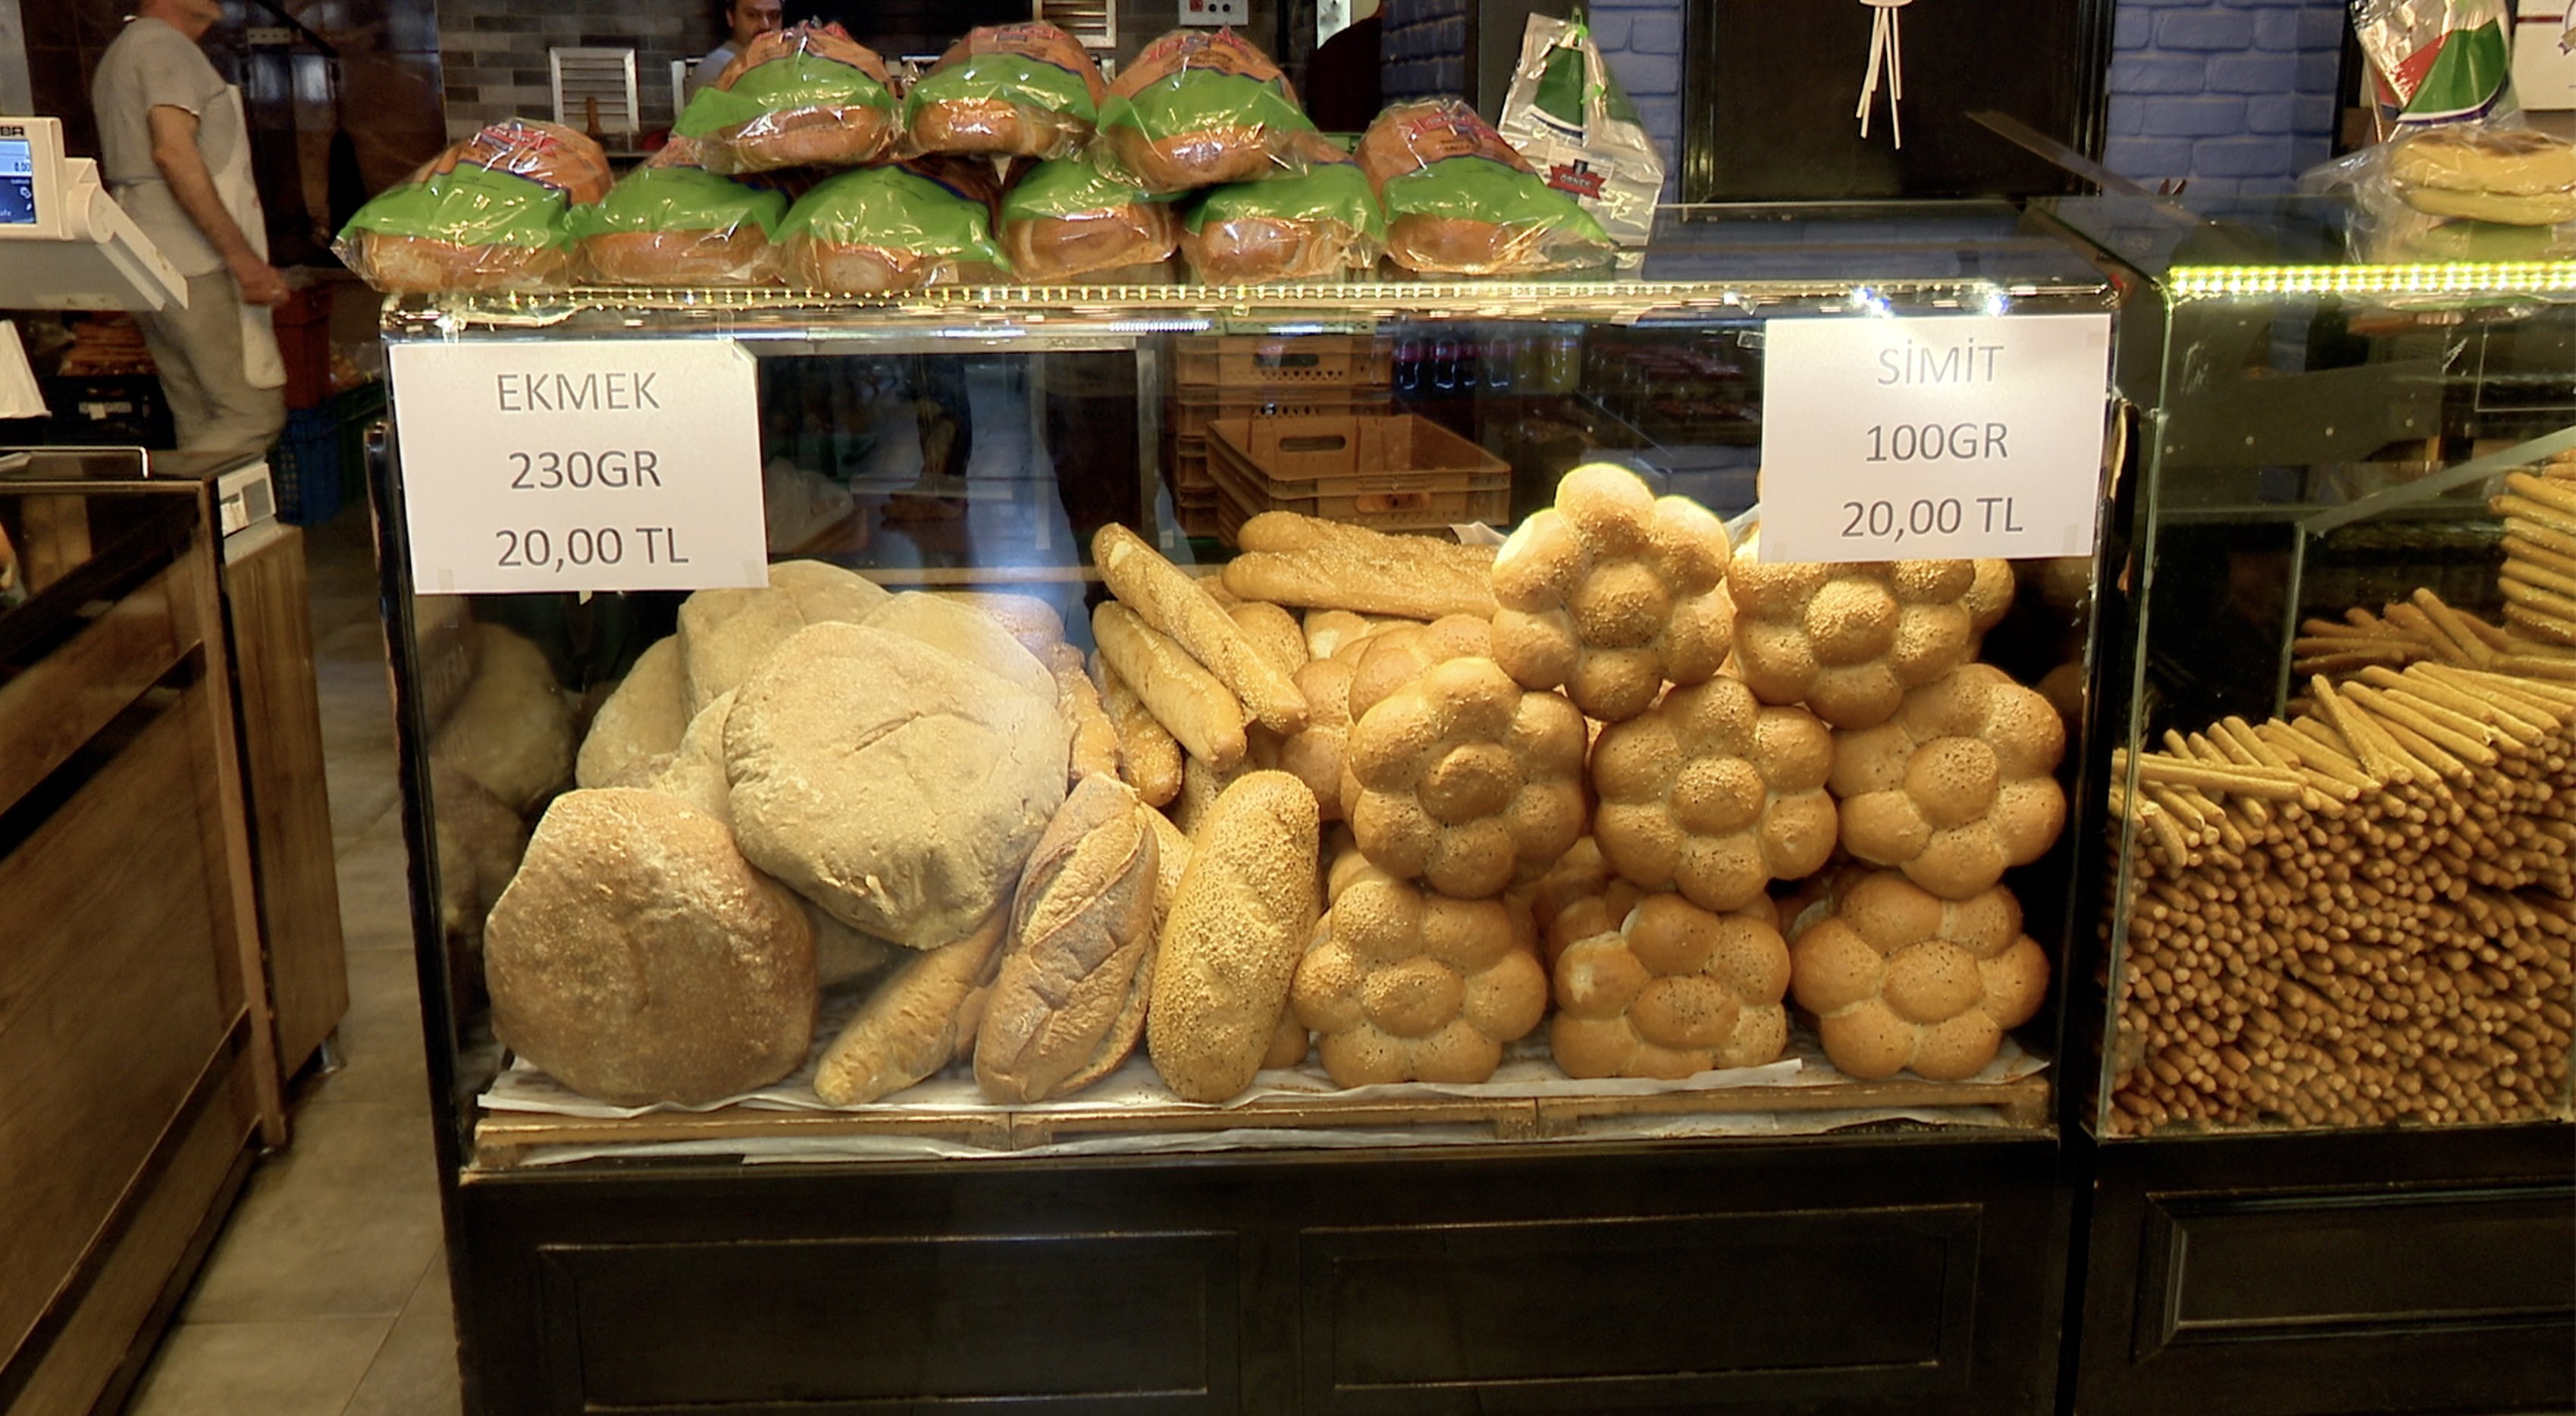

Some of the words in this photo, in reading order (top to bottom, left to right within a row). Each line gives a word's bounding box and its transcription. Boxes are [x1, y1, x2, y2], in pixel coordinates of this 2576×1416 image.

[1878, 337, 2004, 384] SİMİT
[497, 372, 660, 411] EKMEK
[1866, 423, 2007, 462] 100GR
[509, 451, 661, 489] 230GR
[1842, 499, 1962, 542] 20,00
[1976, 497, 2023, 532] TL
[496, 528, 622, 572] 20,00
[636, 528, 688, 563] TL
